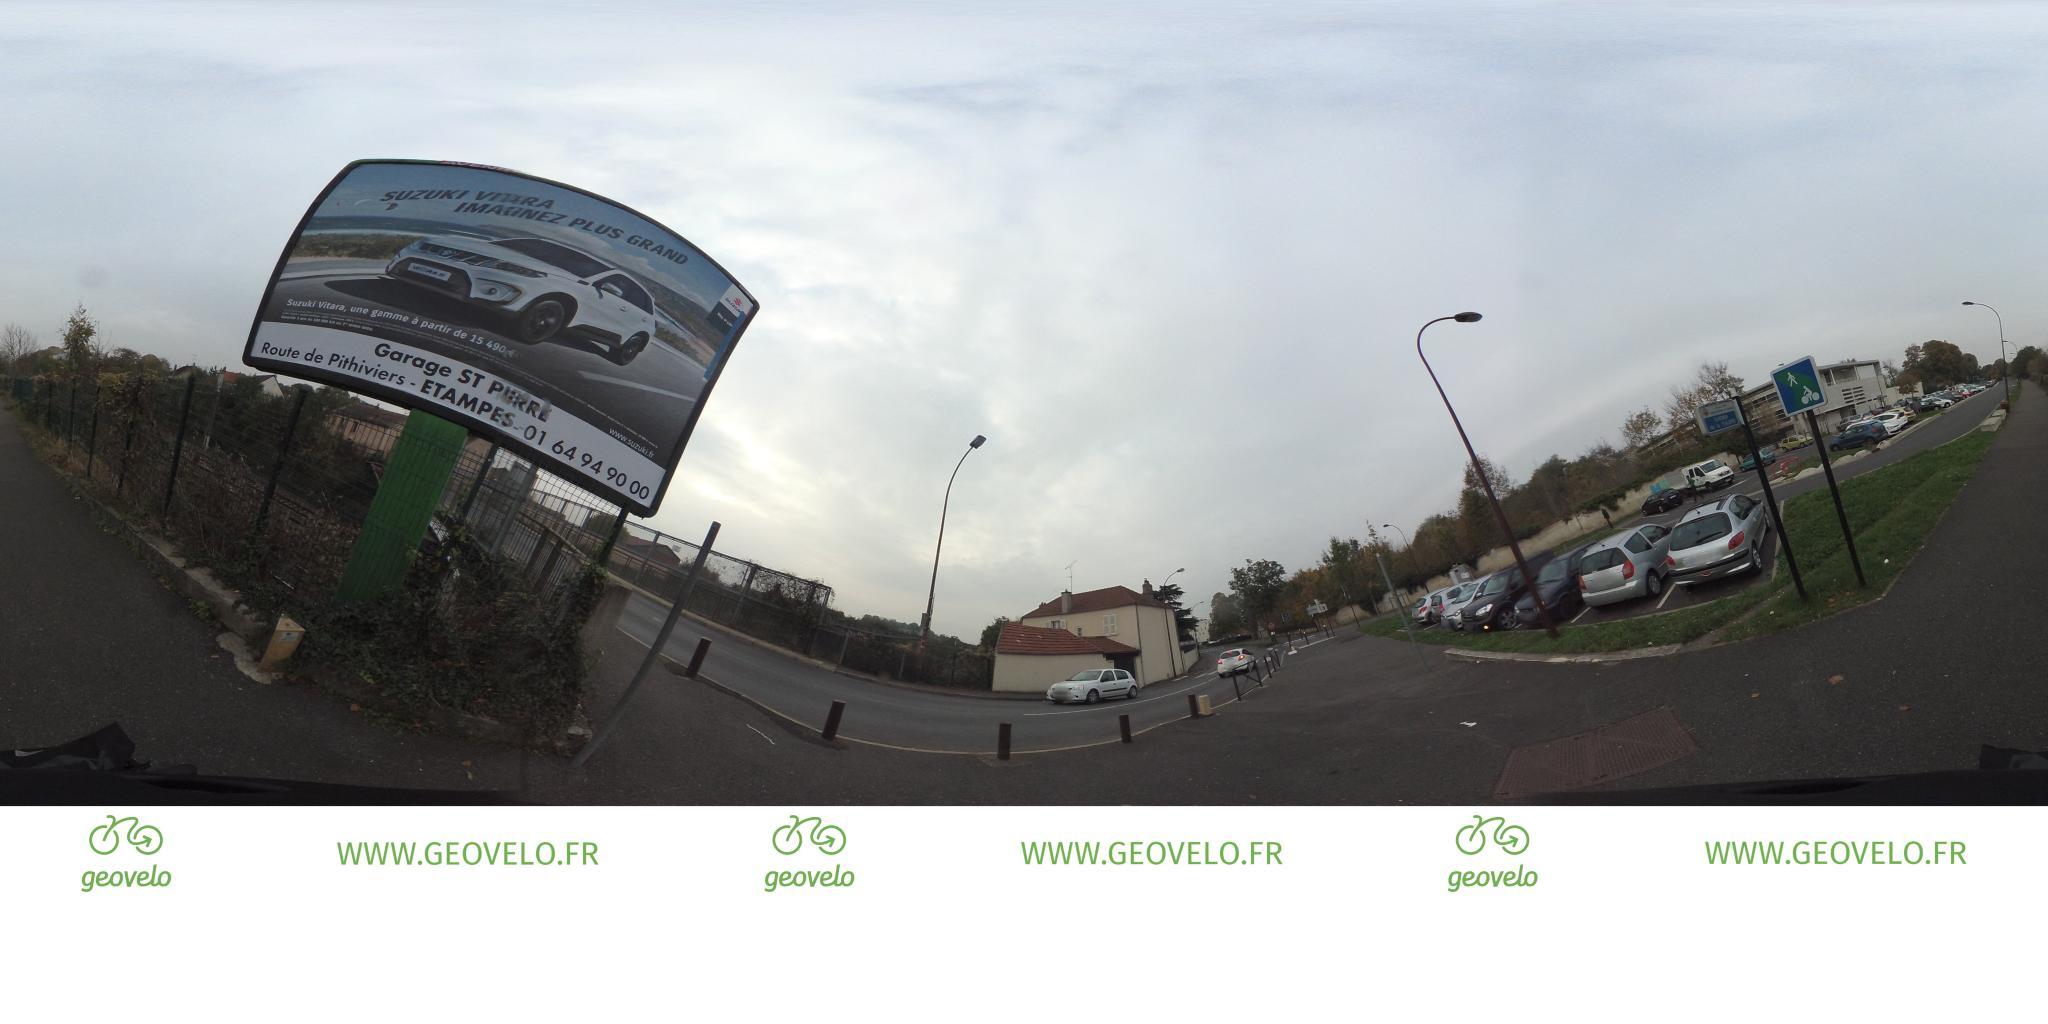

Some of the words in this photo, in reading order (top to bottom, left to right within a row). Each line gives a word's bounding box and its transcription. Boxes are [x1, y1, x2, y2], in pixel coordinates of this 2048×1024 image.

[380, 189, 470, 202] SUZUKI
[568, 217, 625, 239] PLUS
[626, 234, 689, 266] GRAND
[287, 298, 316, 308] Suzuki
[350, 306, 369, 314] une
[371, 309, 409, 323] gamme
[420, 319, 452, 334] partir
[453, 327, 468, 340] de
[469, 333, 484, 345] 15
[374, 342, 452, 378] Garage
[457, 368, 485, 388] ST
[261, 342, 300, 359] Route
[303, 348, 324, 364] de
[328, 353, 406, 386] Pithiviers
[420, 379, 516, 428] ETAMPES
[524, 425, 547, 446] 01
[551, 439, 578, 461] 64
[581, 452, 604, 475] 94
[606, 466, 627, 487] 90
[629, 480, 650, 501] 00
